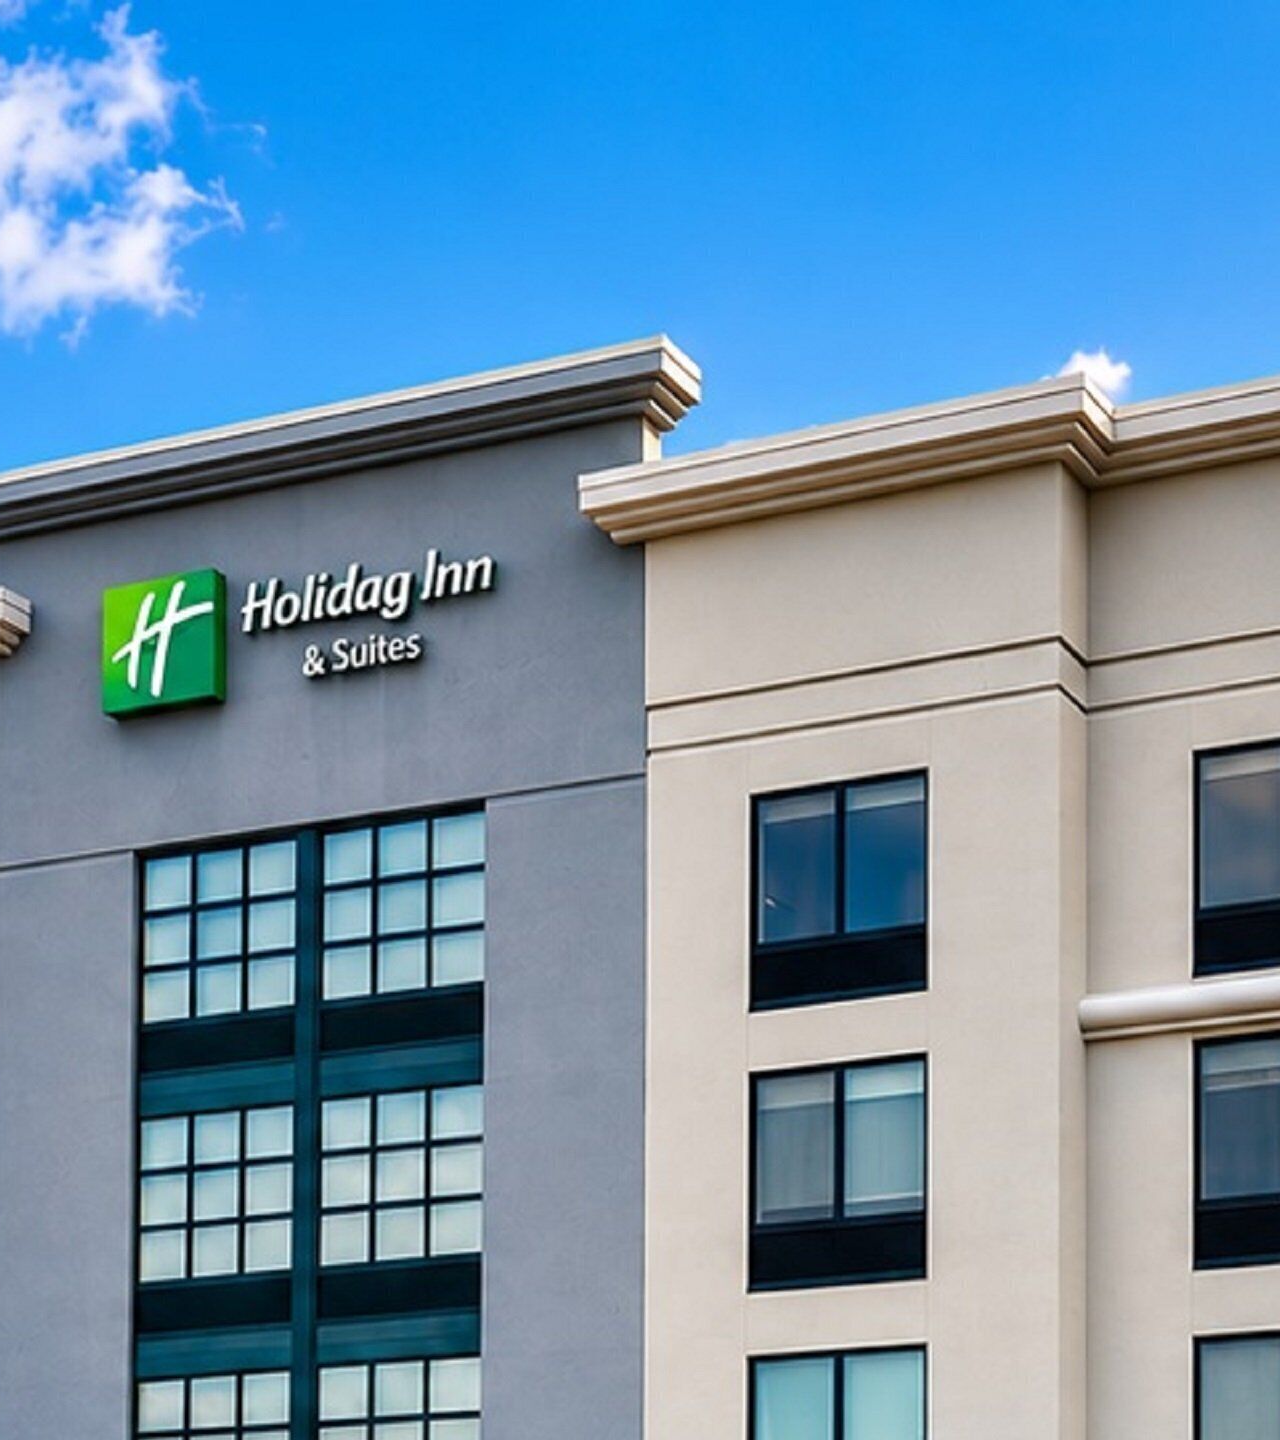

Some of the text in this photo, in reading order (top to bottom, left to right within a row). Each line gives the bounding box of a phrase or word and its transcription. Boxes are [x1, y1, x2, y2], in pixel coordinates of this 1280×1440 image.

[420, 548, 493, 601] Inn
[302, 633, 421, 676] & Suites
